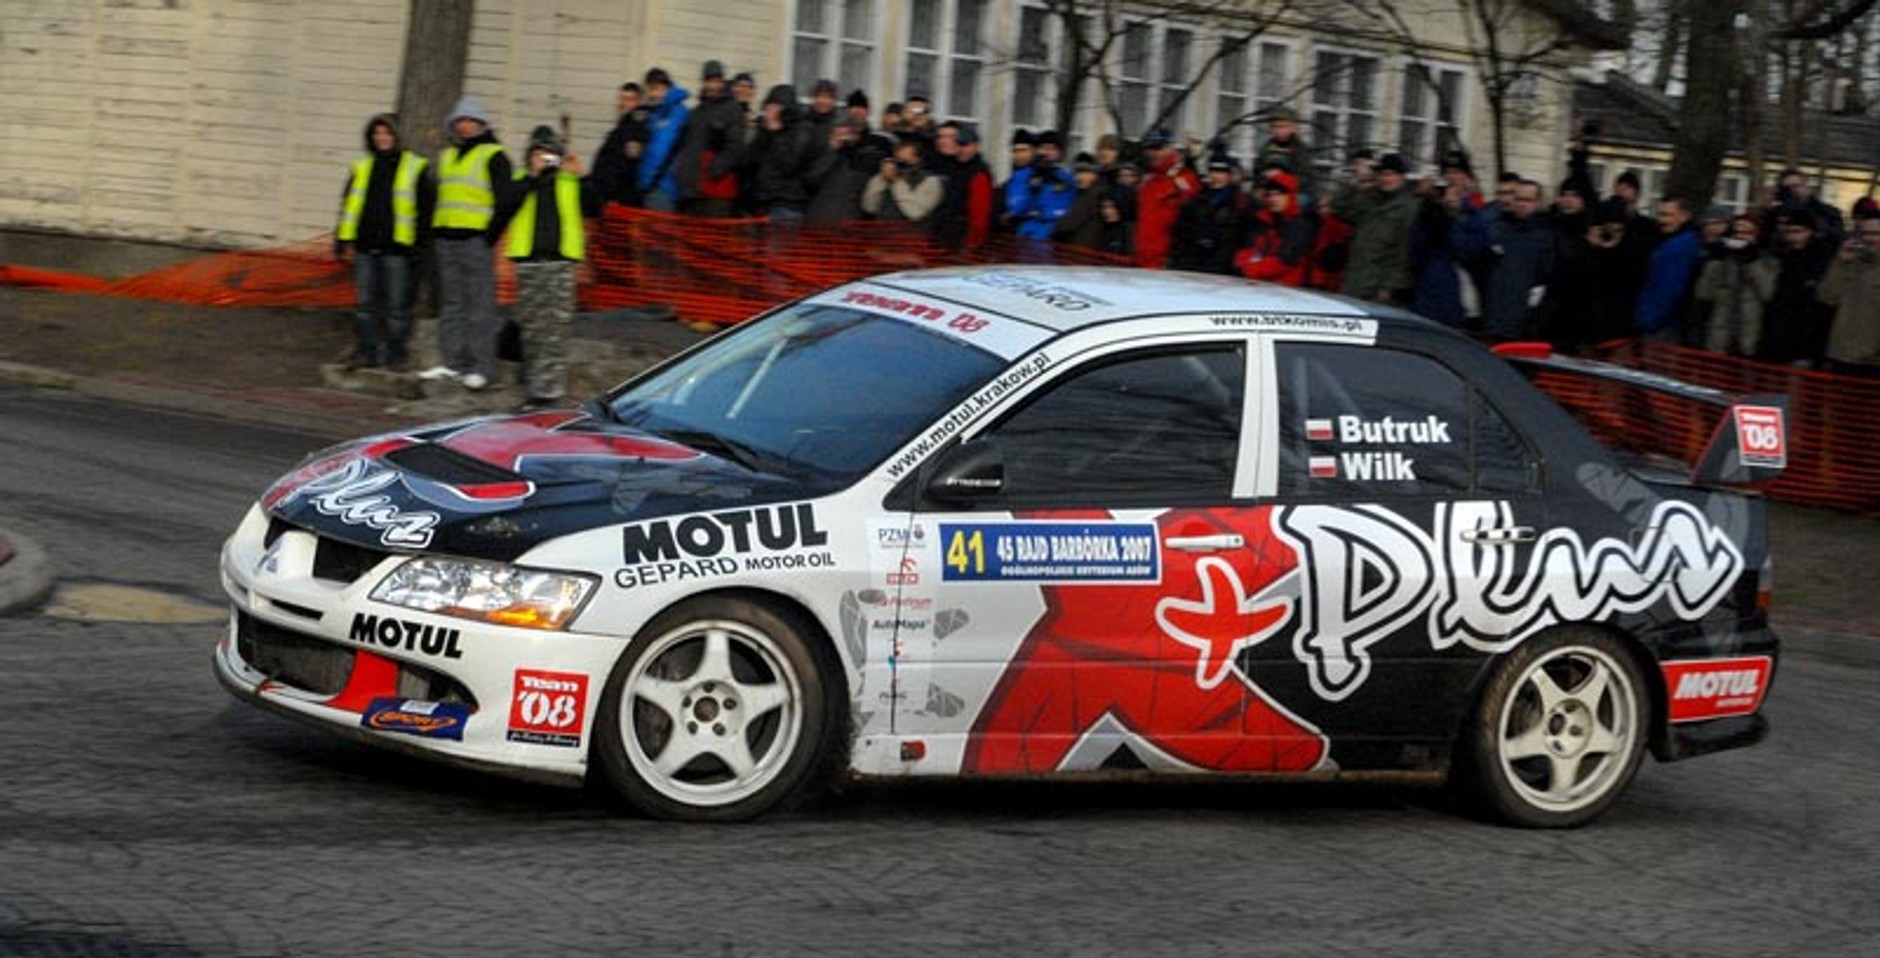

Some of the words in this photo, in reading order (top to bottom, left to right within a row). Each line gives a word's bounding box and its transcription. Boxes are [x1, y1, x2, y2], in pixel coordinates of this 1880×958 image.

[886, 351, 1052, 478] www.motul.krakow.pl
[1338, 414, 1452, 443] Butruk
[1340, 452, 1416, 481] Wilk
[622, 503, 829, 566] MOTUL
[946, 529, 985, 575] 41
[996, 534, 1014, 562] 45
[1015, 535, 1049, 562] RAJD
[1050, 528, 1119, 562] BARBÓRKA
[1120, 535, 1152, 562] 2007
[613, 556, 739, 589] GEPARD
[745, 554, 806, 571] MOTOR
[808, 551, 836, 567] OIL
[1269, 499, 1745, 702] Plus
[348, 612, 464, 659] MOTUL
[1673, 668, 1760, 699] MOTUL
